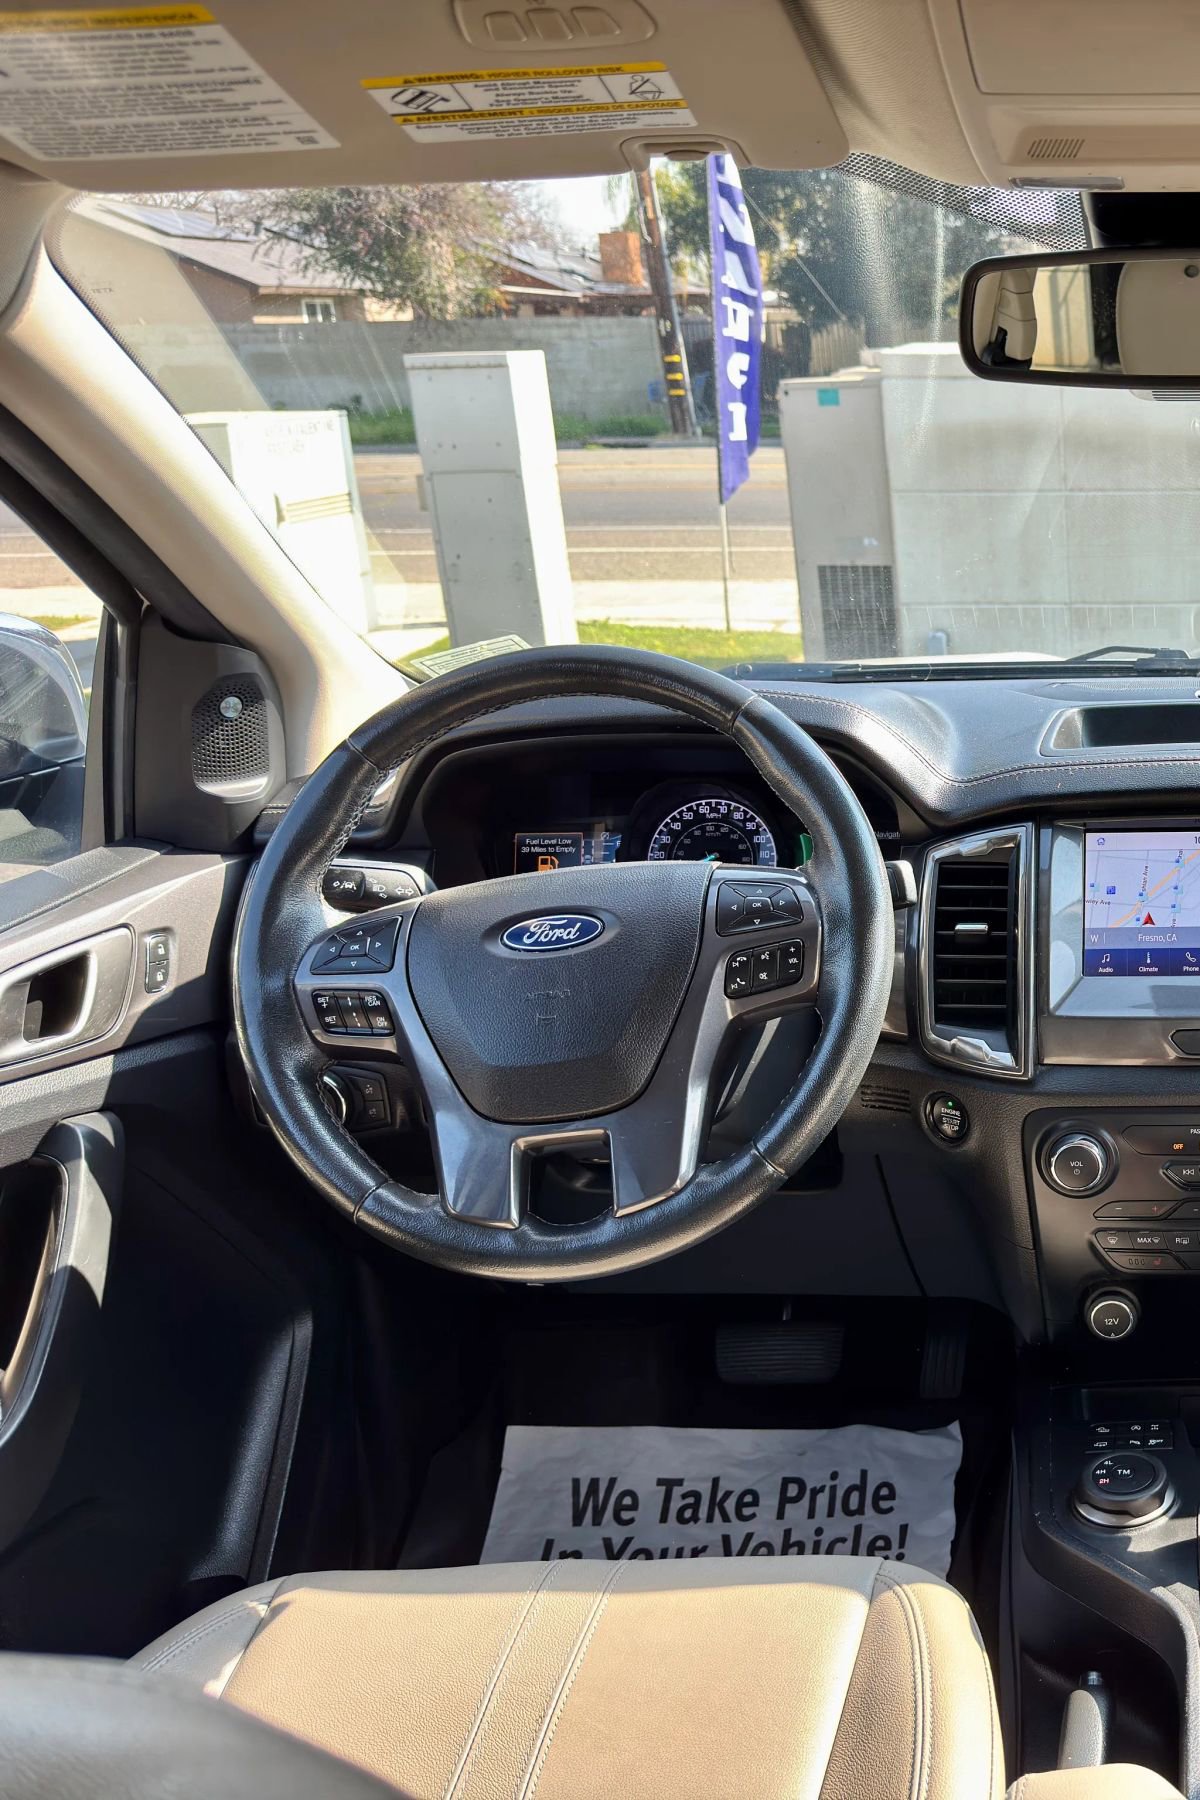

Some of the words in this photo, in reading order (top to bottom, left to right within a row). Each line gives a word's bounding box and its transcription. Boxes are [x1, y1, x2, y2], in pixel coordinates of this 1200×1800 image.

[699, 806, 710, 814] 60
[717, 805, 728, 814] 70
[682, 812, 694, 820] 50
[733, 812, 744, 820] 80
[670, 822, 681, 830] 40
[745, 822, 756, 830] 90
[660, 835, 671, 843] 30
[753, 835, 766, 843] 100
[555, 846, 576, 854] Empty
[523, 918, 581, 945] Ford
[1090, 934, 1099, 943] W
[1138, 933, 1165, 943] Fresno,
[1166, 933, 1177, 942] CA
[1138, 965, 1159, 973] Climate
[324, 1015, 337, 1023] SET
[941, 1107, 961, 1117] ENGINE
[942, 1117, 961, 1126] START
[1104, 1317, 1120, 1326] 12V
[571, 1477, 640, 1527] We
[656, 1476, 760, 1525] Take
[776, 1468, 897, 1521] Pride
